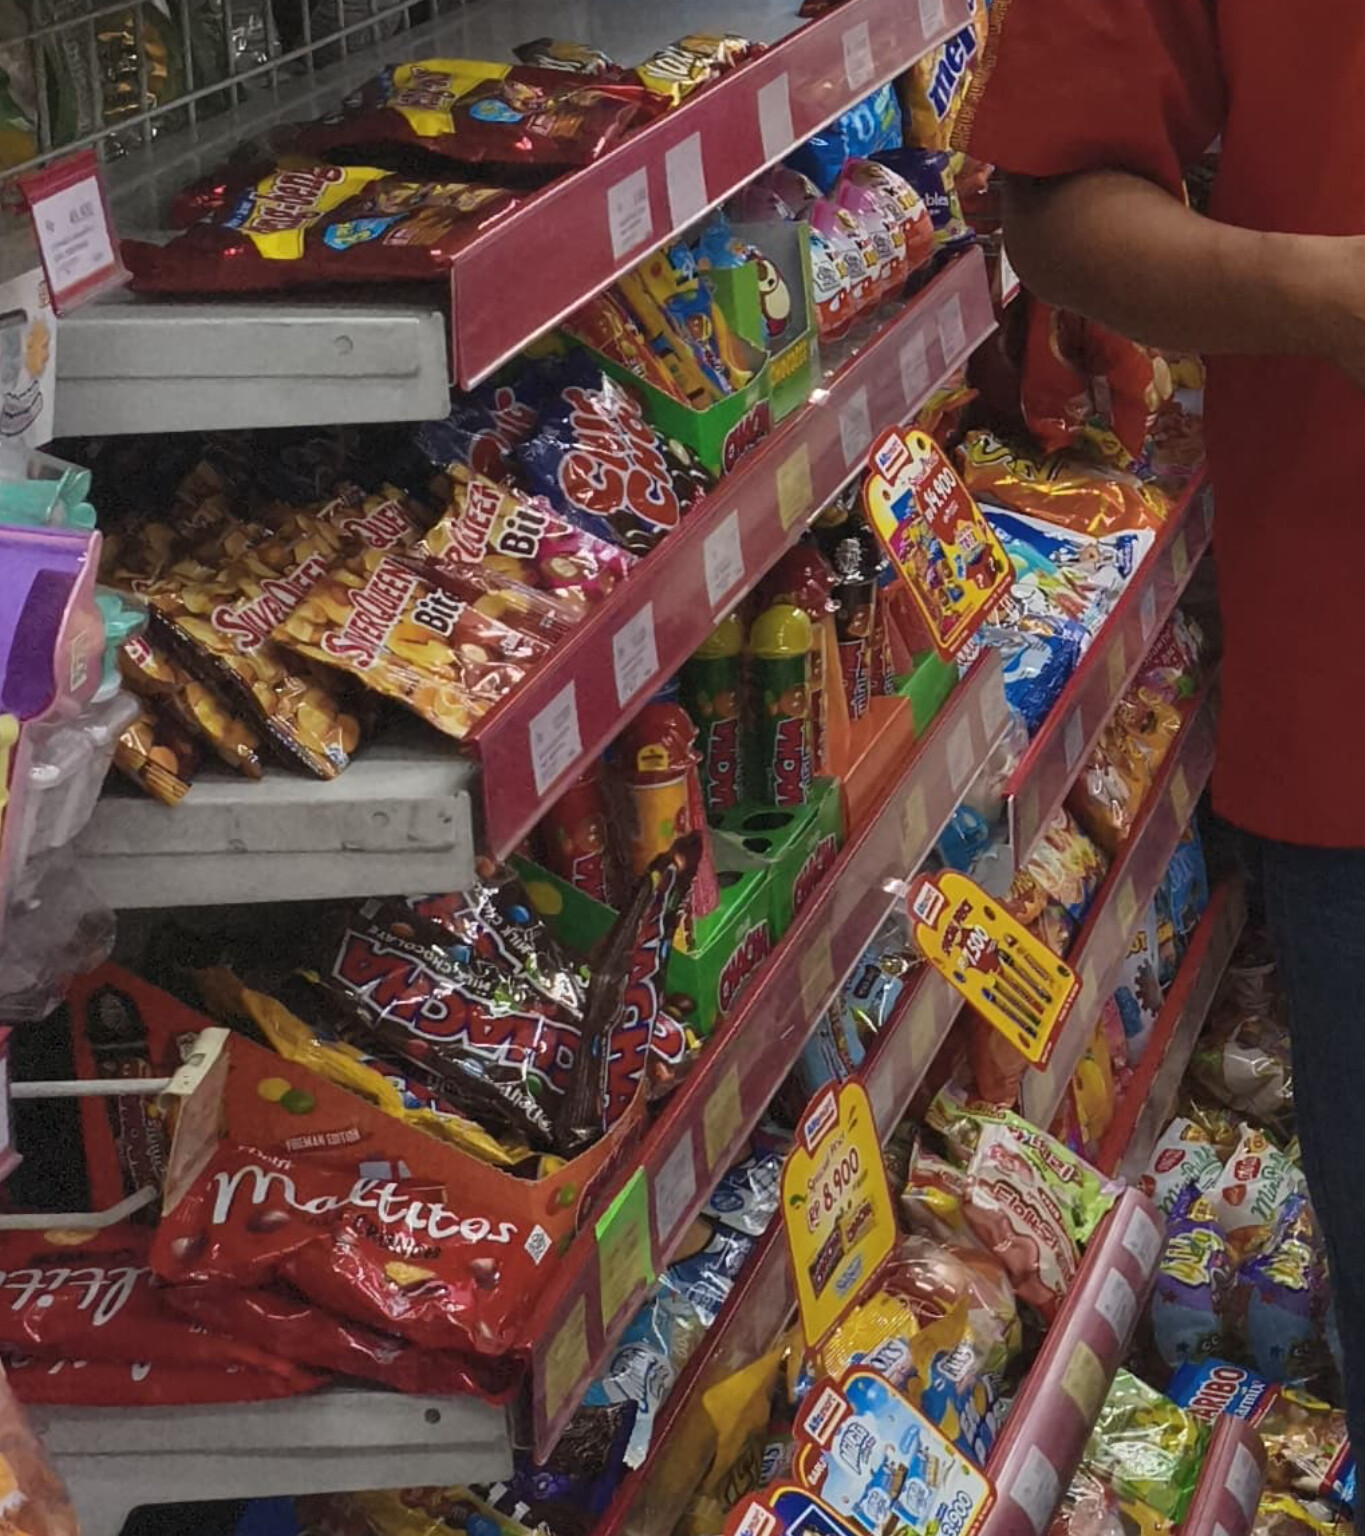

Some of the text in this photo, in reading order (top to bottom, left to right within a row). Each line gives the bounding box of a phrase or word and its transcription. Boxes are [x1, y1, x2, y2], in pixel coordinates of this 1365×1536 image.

[211, 1164, 521, 1246] Maltitos
[823, 1147, 859, 1212] 8.900
[1235, 1380, 1263, 1421] armix
